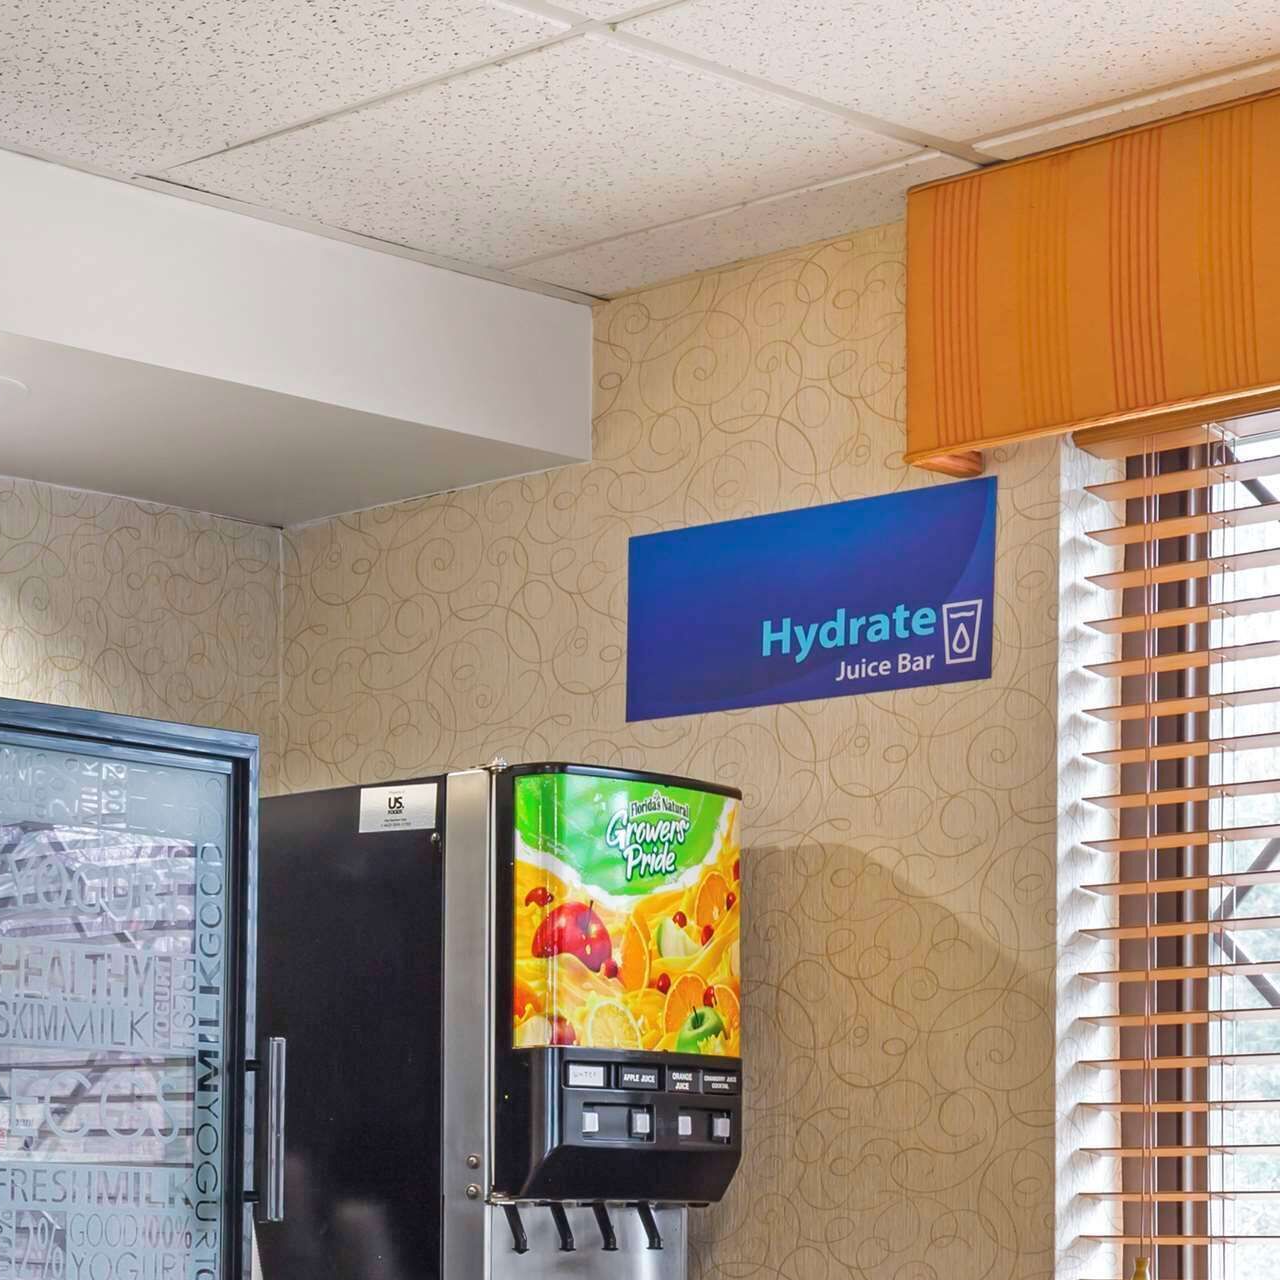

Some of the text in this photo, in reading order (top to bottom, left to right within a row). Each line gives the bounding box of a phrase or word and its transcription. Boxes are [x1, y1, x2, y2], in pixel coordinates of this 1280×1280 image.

[761, 604, 937, 663] Hydrate
[835, 653, 936, 681] Juice Bar
[662, 798, 689, 817] Natural
[606, 809, 690, 850] Growers
[623, 841, 676, 880] Pride
[197, 959, 221, 1093] MILK
[624, 1074, 655, 1083] APPLE JUICE
[672, 1072, 692, 1081] ORANGE
[675, 1082, 689, 1090] JUICE
[194, 1097, 220, 1269] YOGURT
[69, 1212, 138, 1248] GOOD
